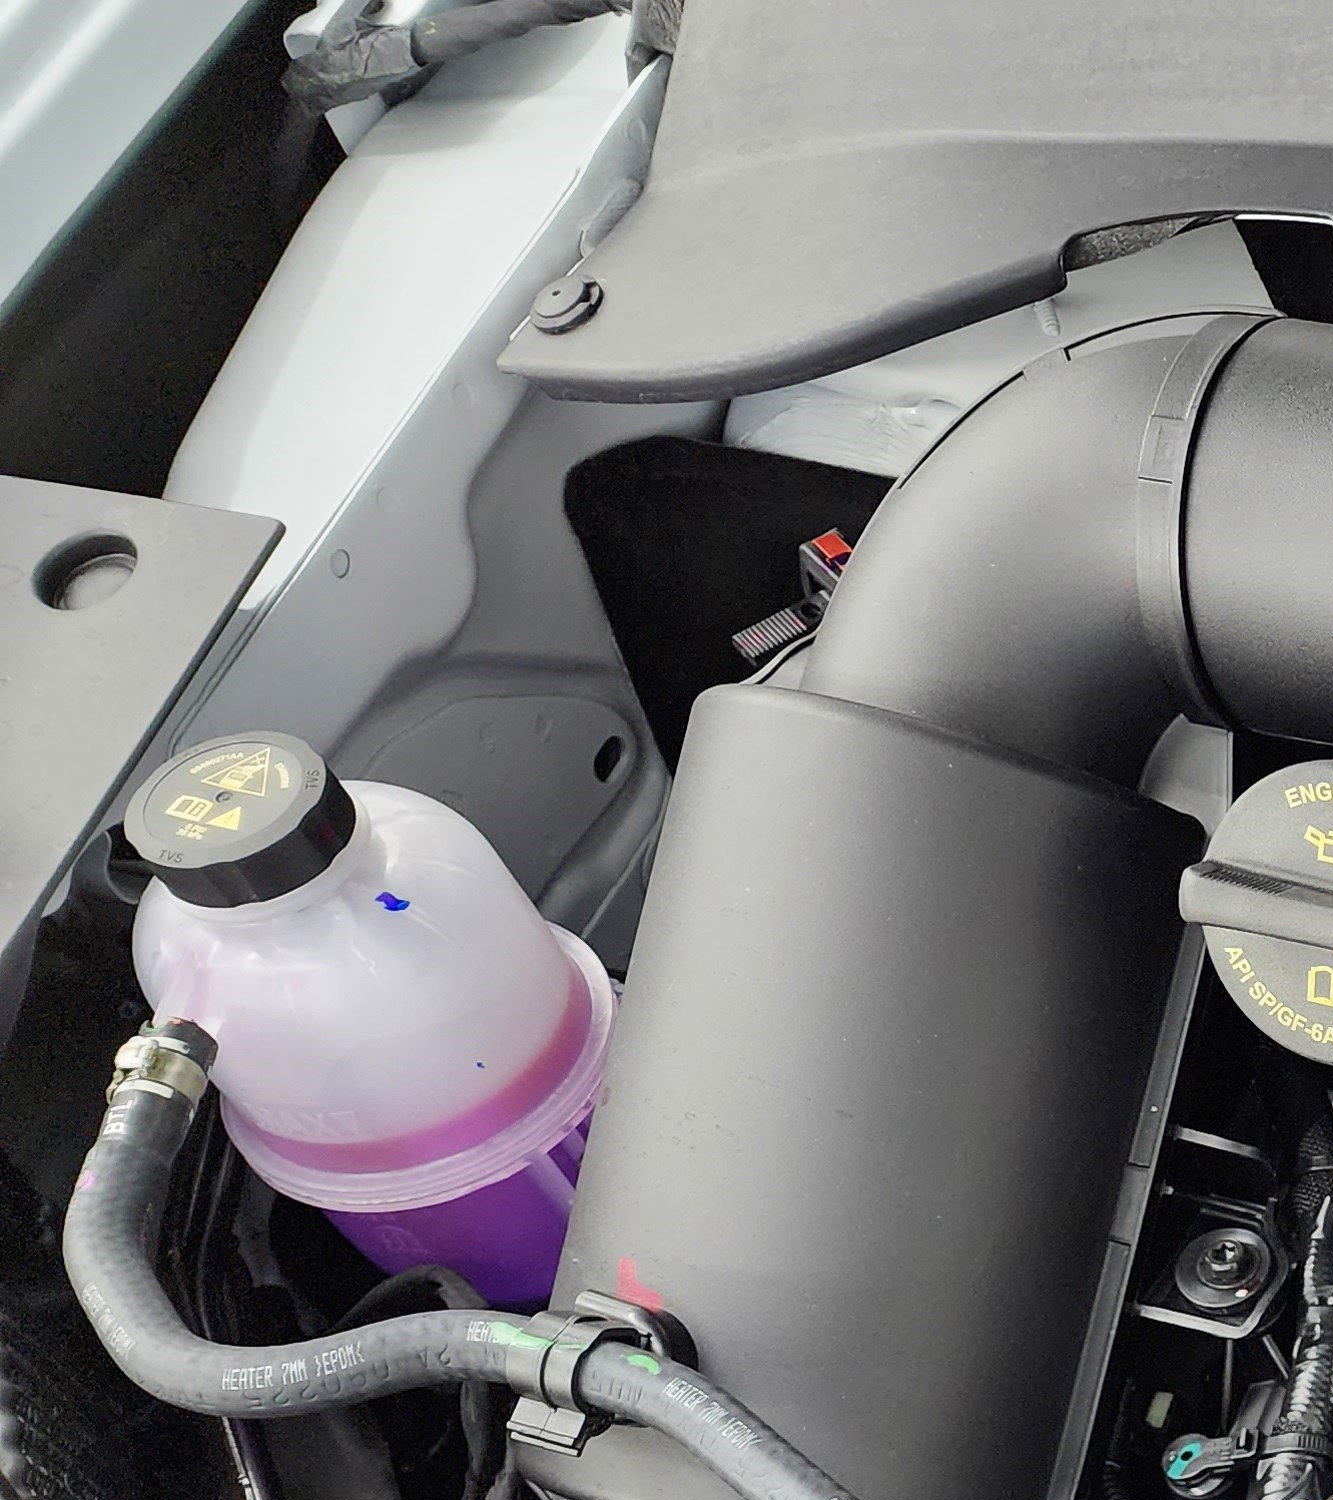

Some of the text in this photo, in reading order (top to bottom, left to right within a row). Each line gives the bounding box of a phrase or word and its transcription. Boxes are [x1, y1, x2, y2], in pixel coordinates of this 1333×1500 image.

[304, 769, 320, 790] TVS
[158, 849, 184, 864] TVS
[1224, 946, 1257, 984] API
[102, 1099, 138, 1137] BTL
[221, 1365, 274, 1391] HEATER
[280, 1358, 309, 1386] 7MM
[662, 1376, 710, 1412] HEATER
